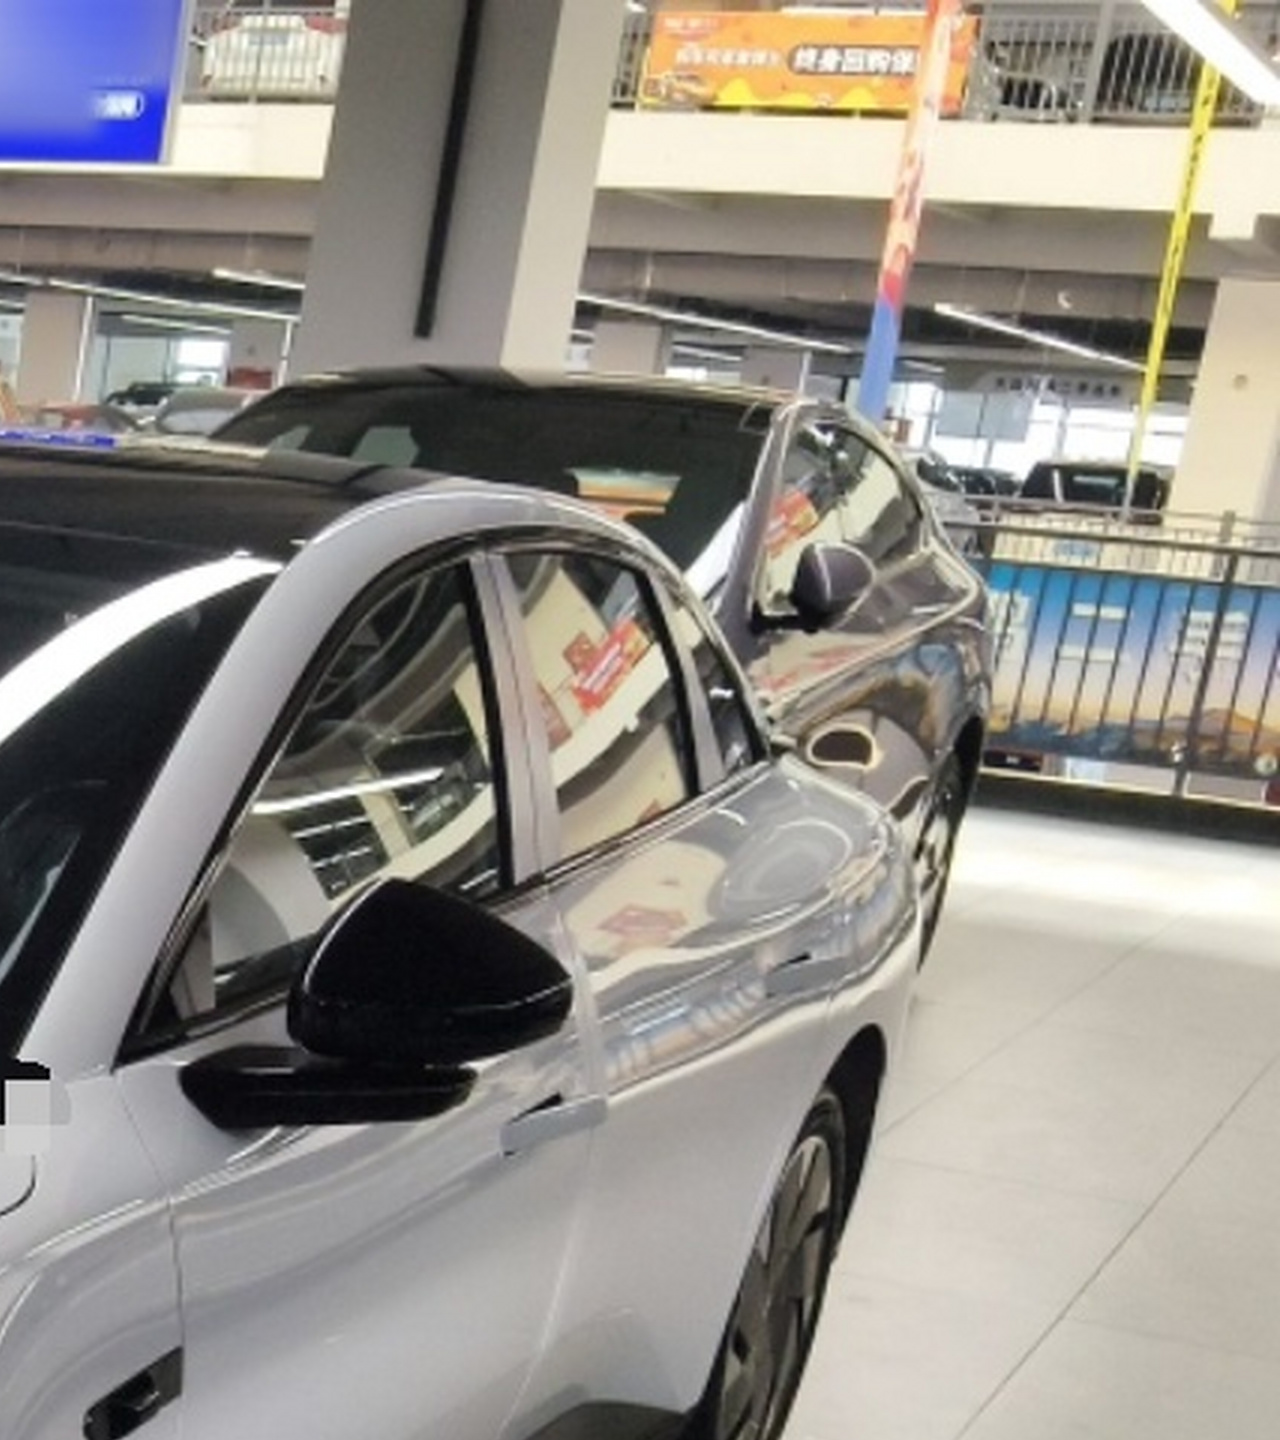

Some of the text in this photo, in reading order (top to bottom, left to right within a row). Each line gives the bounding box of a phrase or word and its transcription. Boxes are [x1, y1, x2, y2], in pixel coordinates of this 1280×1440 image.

[793, 46, 920, 76] 终身回购保
